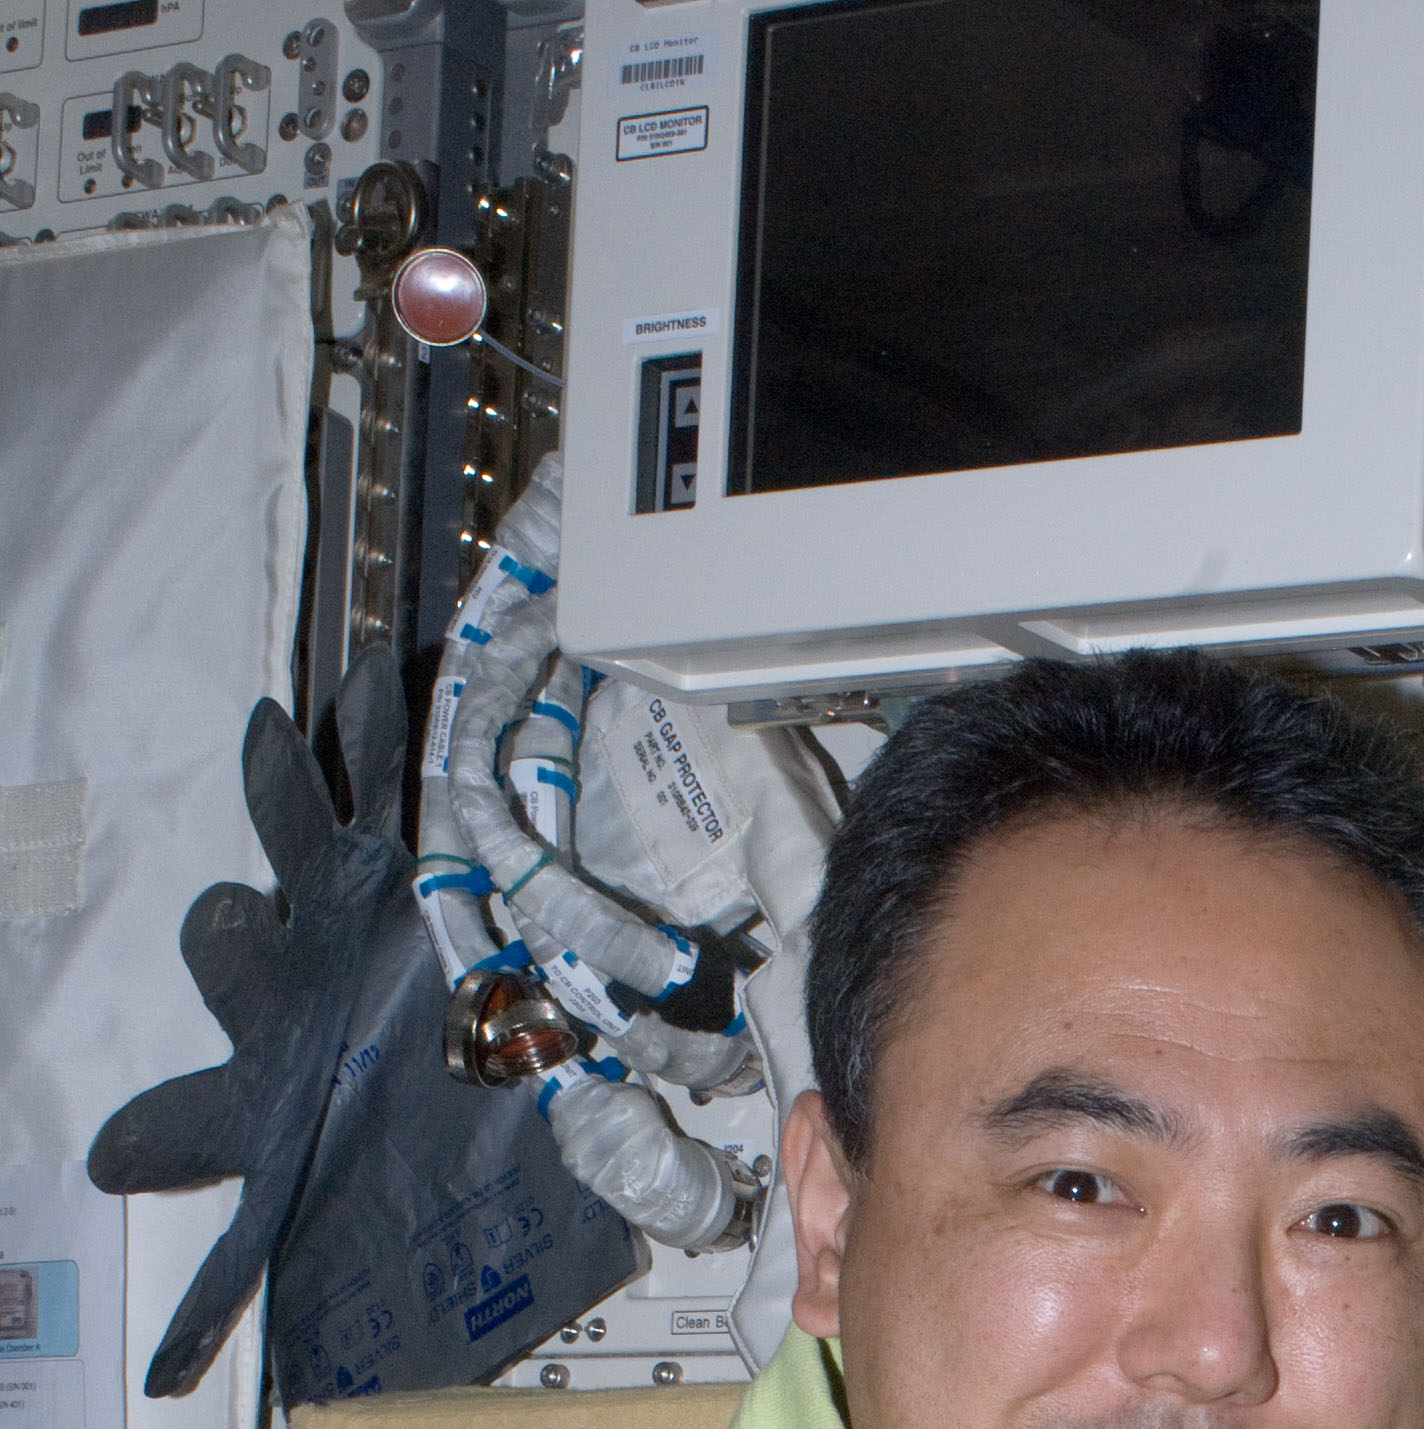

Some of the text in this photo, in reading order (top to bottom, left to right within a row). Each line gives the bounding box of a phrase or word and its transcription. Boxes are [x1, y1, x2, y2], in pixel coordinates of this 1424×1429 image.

[639, 121, 658, 133] LCD
[660, 114, 703, 130] MONITOR
[635, 316, 707, 336] BRIGHTNESS
[649, 698, 667, 723] CB
[660, 721, 683, 754] GAP
[673, 752, 724, 844] PROTECTOR
[470, 1279, 530, 1334] NORTH
[676, 1315, 710, 1331] Clean
